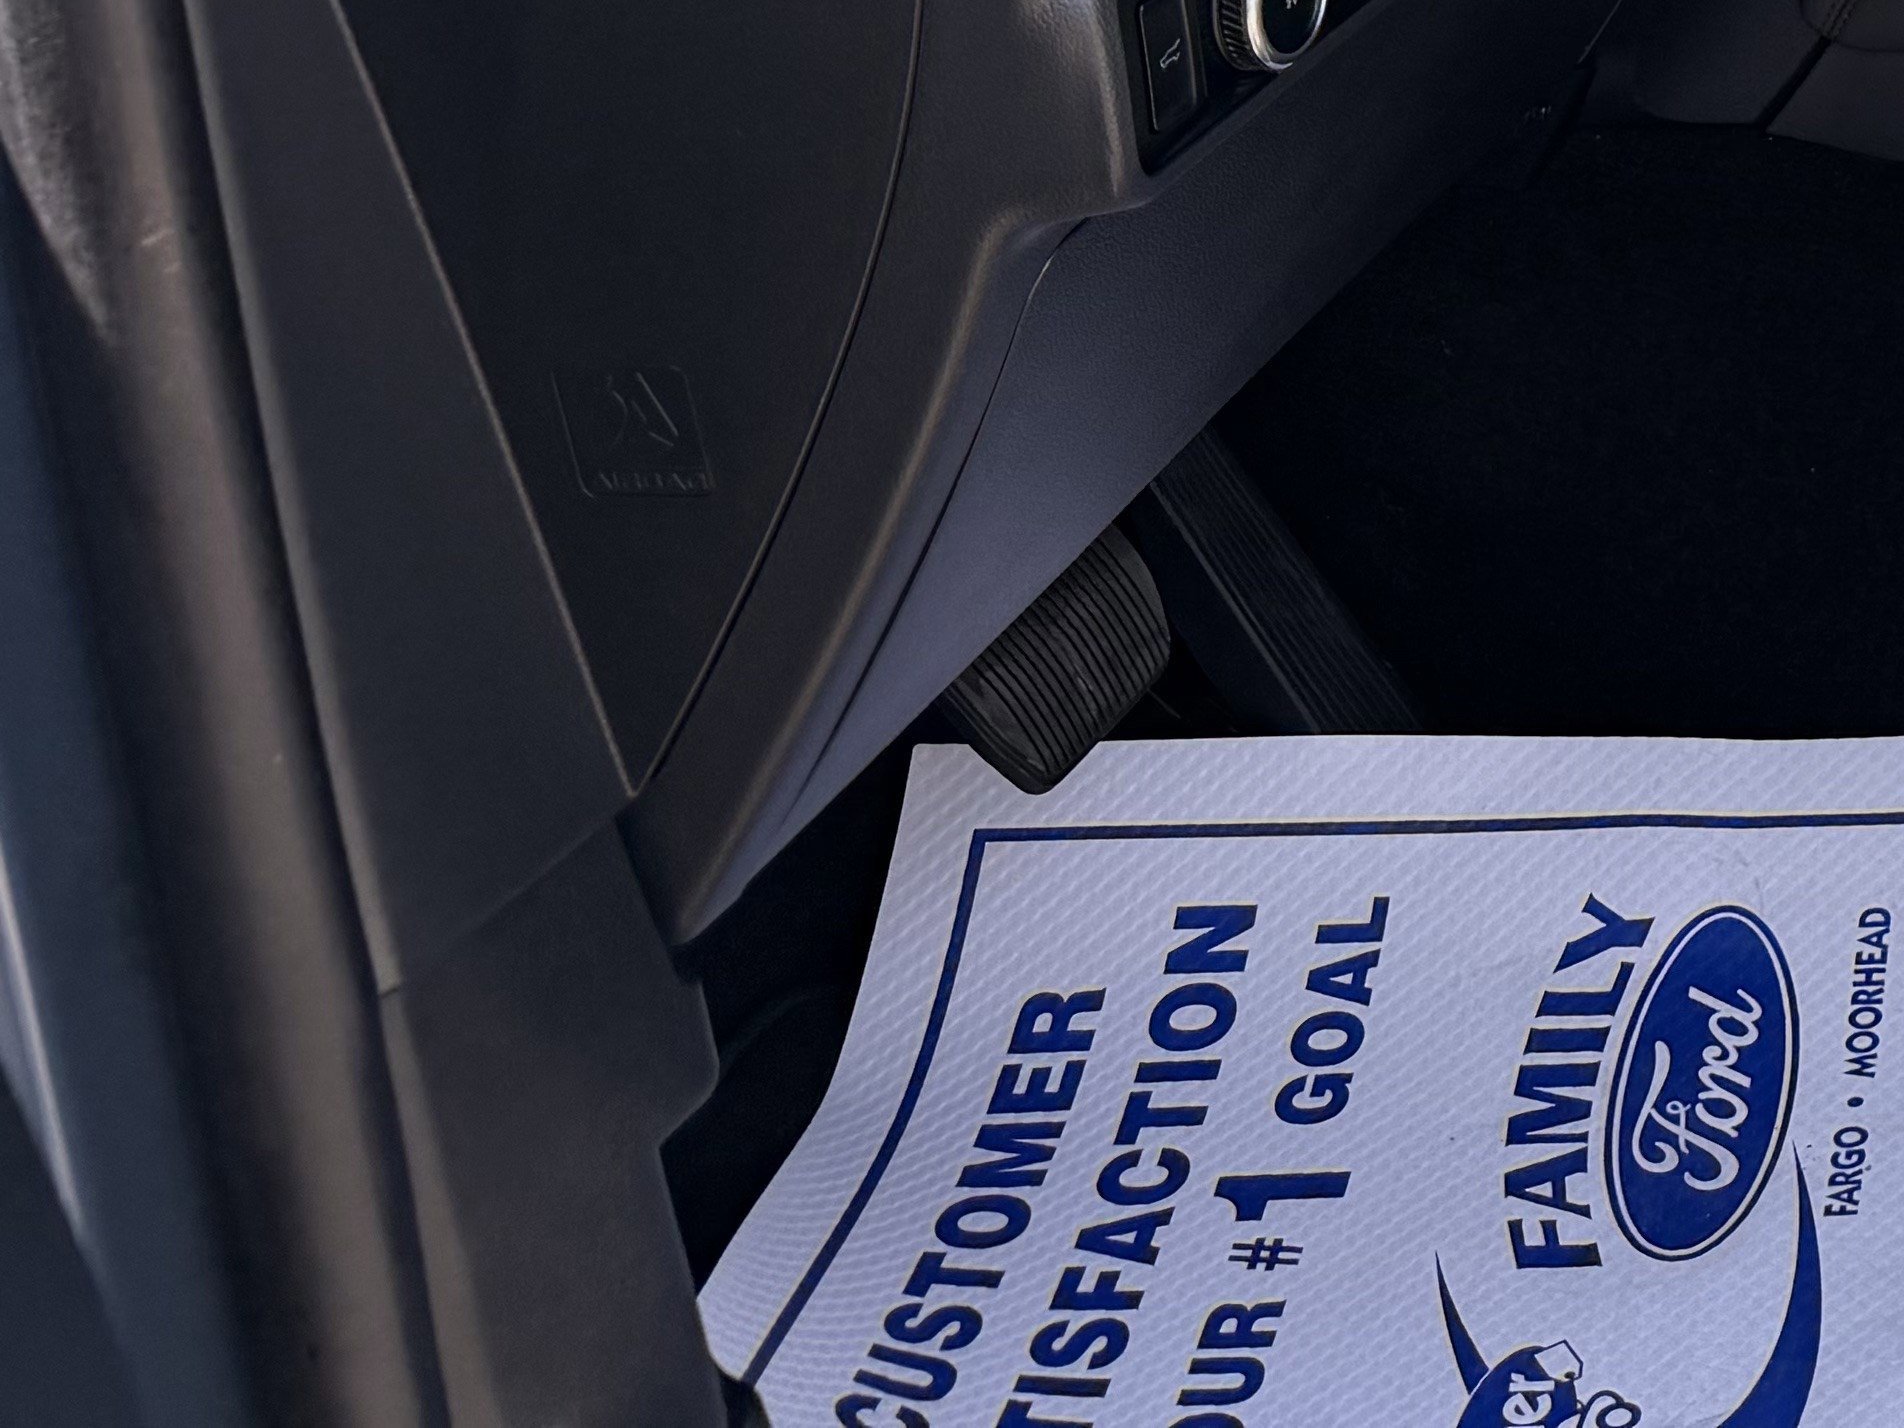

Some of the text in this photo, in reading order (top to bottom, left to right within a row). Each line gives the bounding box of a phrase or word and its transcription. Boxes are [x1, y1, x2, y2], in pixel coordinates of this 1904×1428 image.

[834, 988, 1107, 1428] CUSTOMER
[1168, 896, 1390, 1428] UR #1 GOAL
[1503, 892, 1656, 1269] FAMILY
[1631, 987, 1763, 1192] Ford
[1823, 906, 1892, 1218] FARGO MOORHEAD
[1502, 1372, 1556, 1428] er
